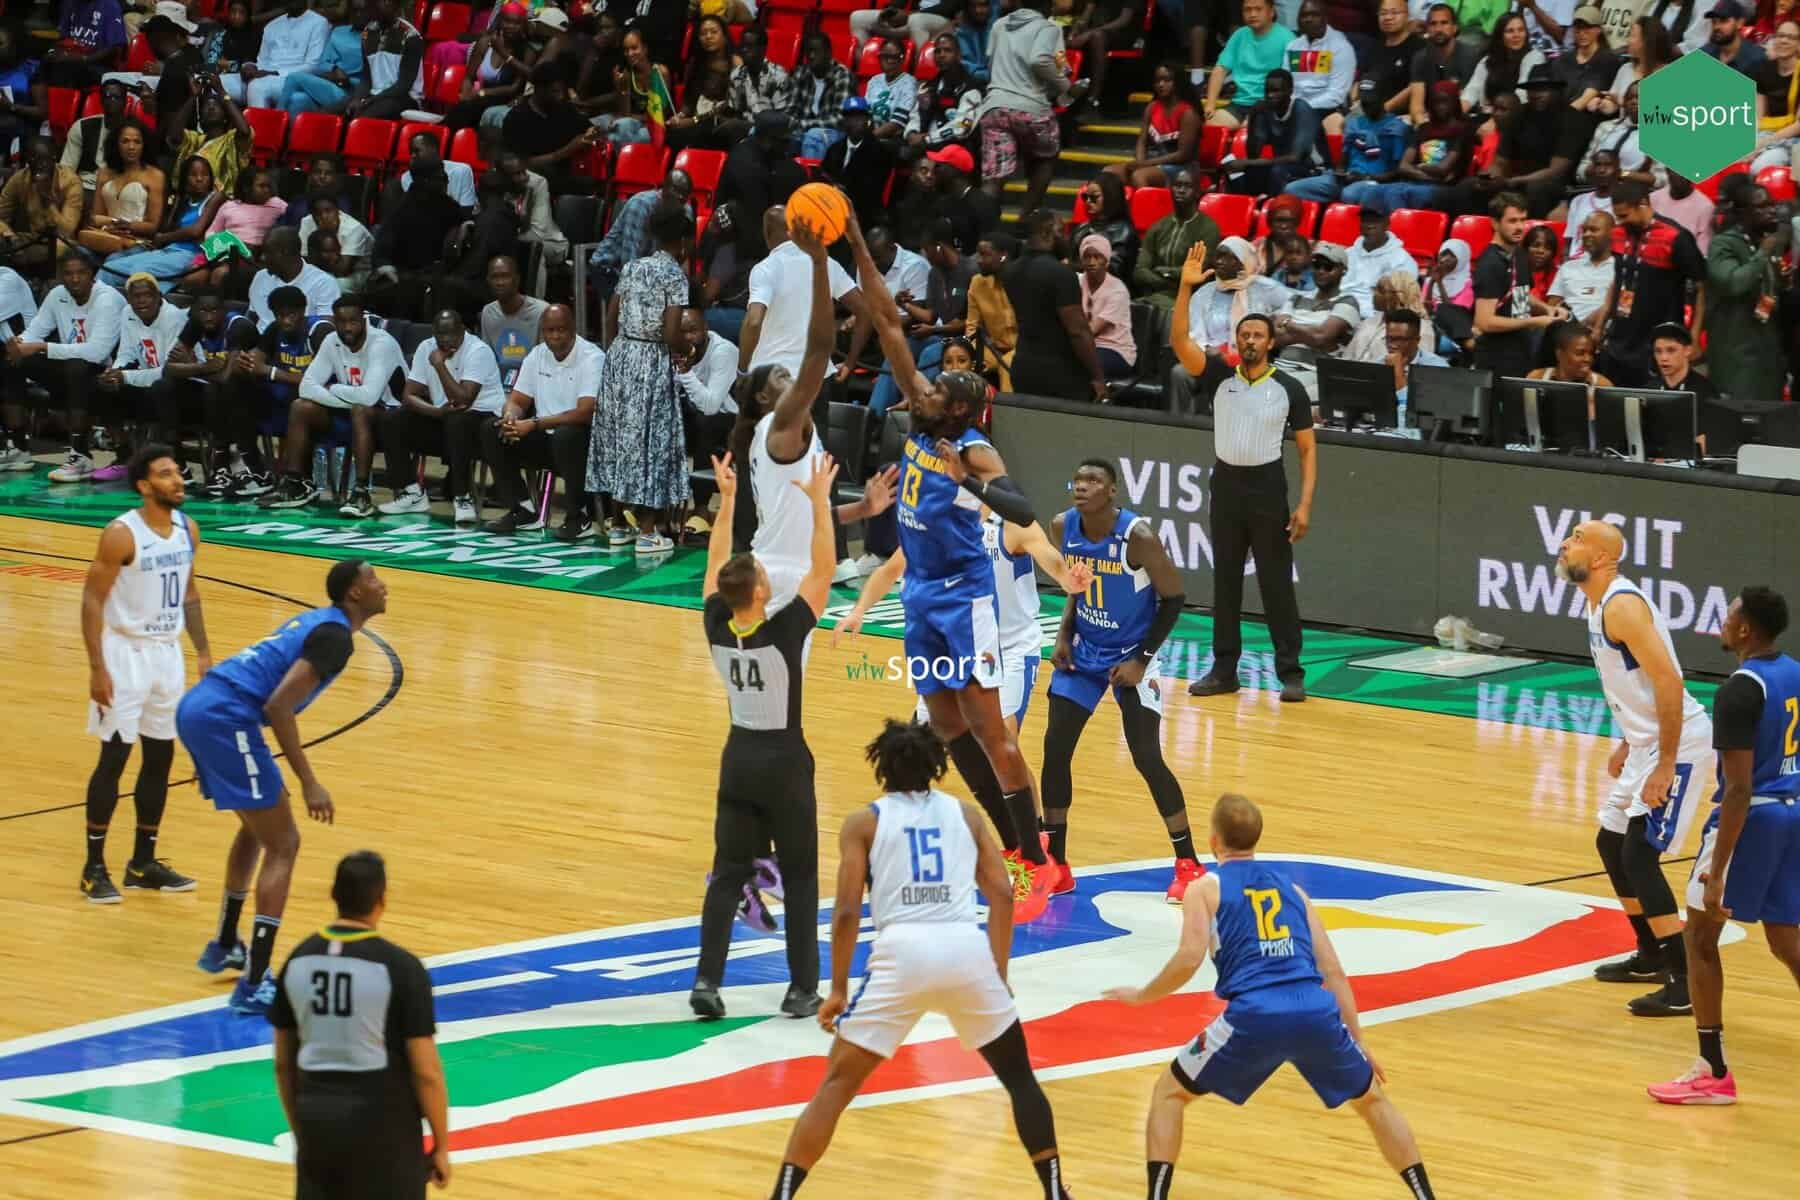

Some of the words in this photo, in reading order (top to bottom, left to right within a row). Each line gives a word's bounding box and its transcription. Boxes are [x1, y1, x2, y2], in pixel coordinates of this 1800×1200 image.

[161, 571, 179, 609] 10
[730, 657, 765, 692] 44
[903, 827, 944, 882] 15
[902, 885, 952, 905] ELDRIDGE
[1243, 888, 1290, 940] 12
[311, 970, 352, 1017] 30
